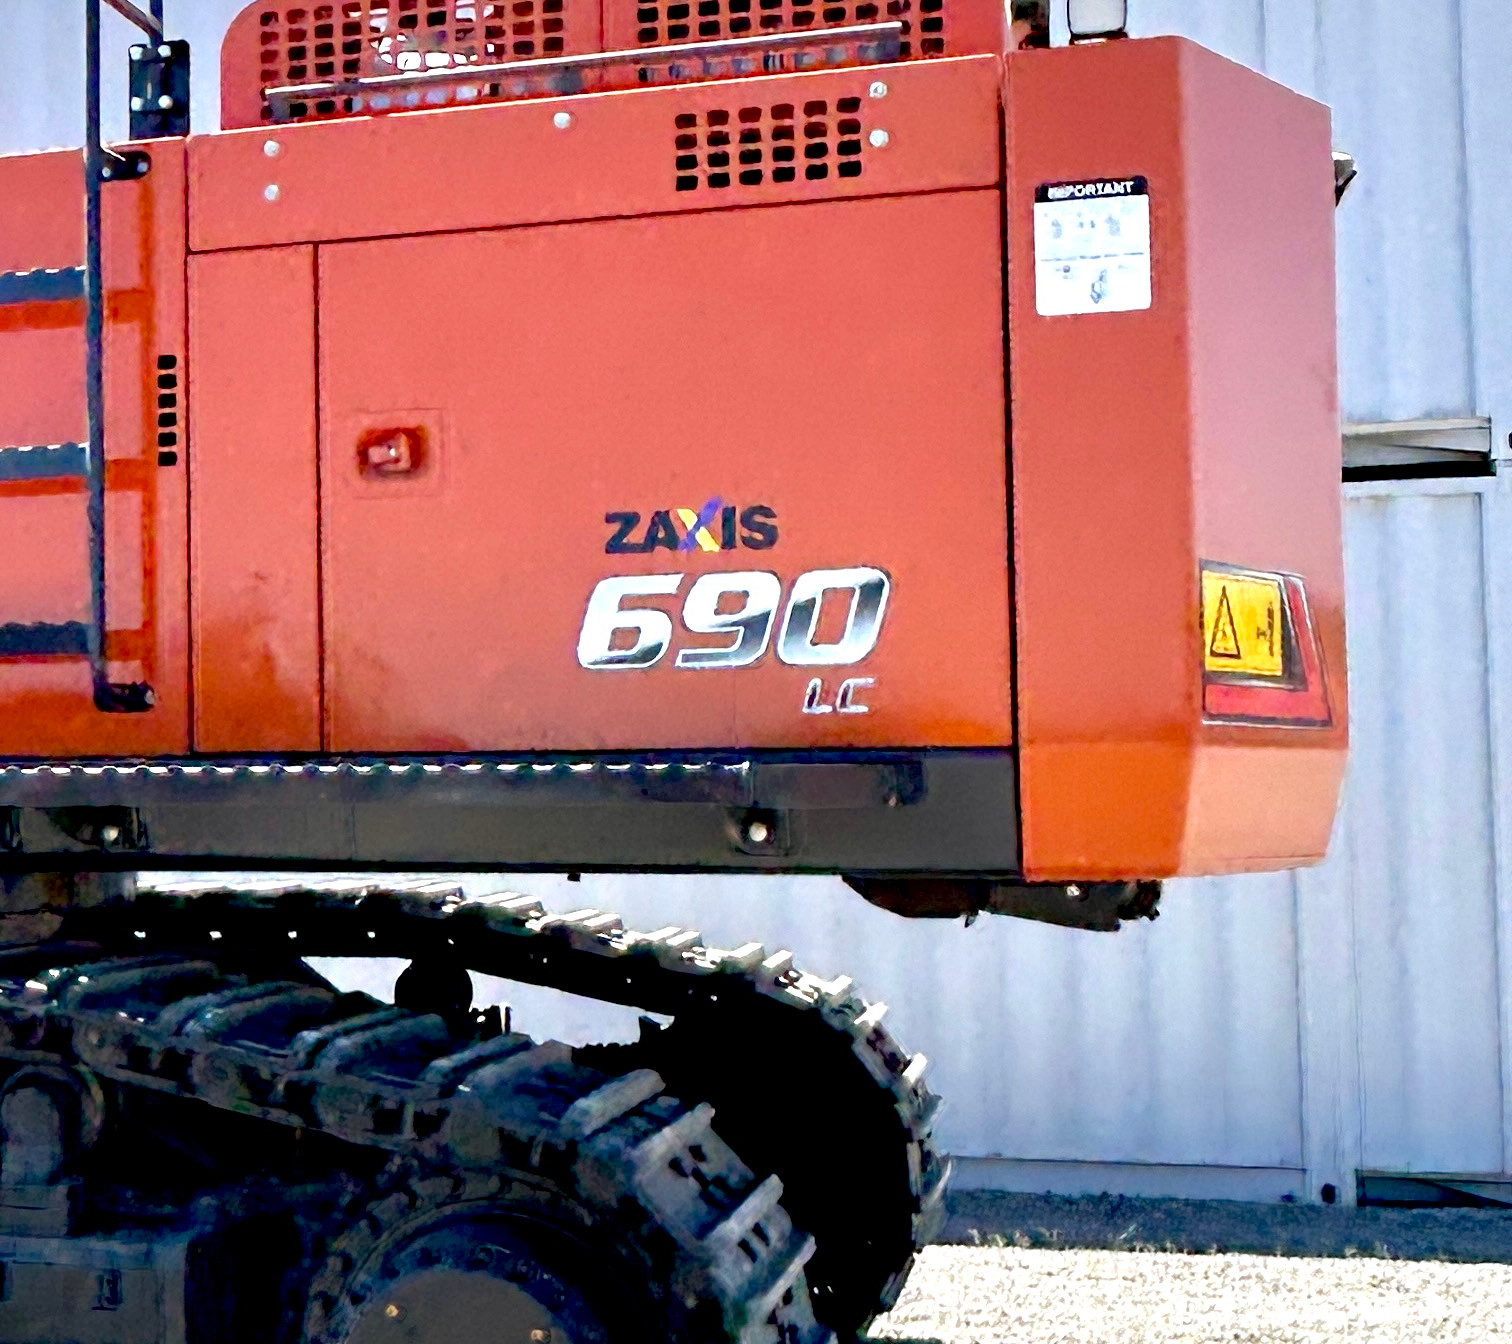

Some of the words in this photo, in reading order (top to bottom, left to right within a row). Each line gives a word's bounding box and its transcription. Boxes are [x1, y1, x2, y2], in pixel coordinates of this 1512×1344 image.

[1047, 181, 1135, 199] IMPORTANT
[604, 497, 780, 554] ZAXIS
[577, 566, 891, 670] 690
[802, 677, 876, 715] LC
